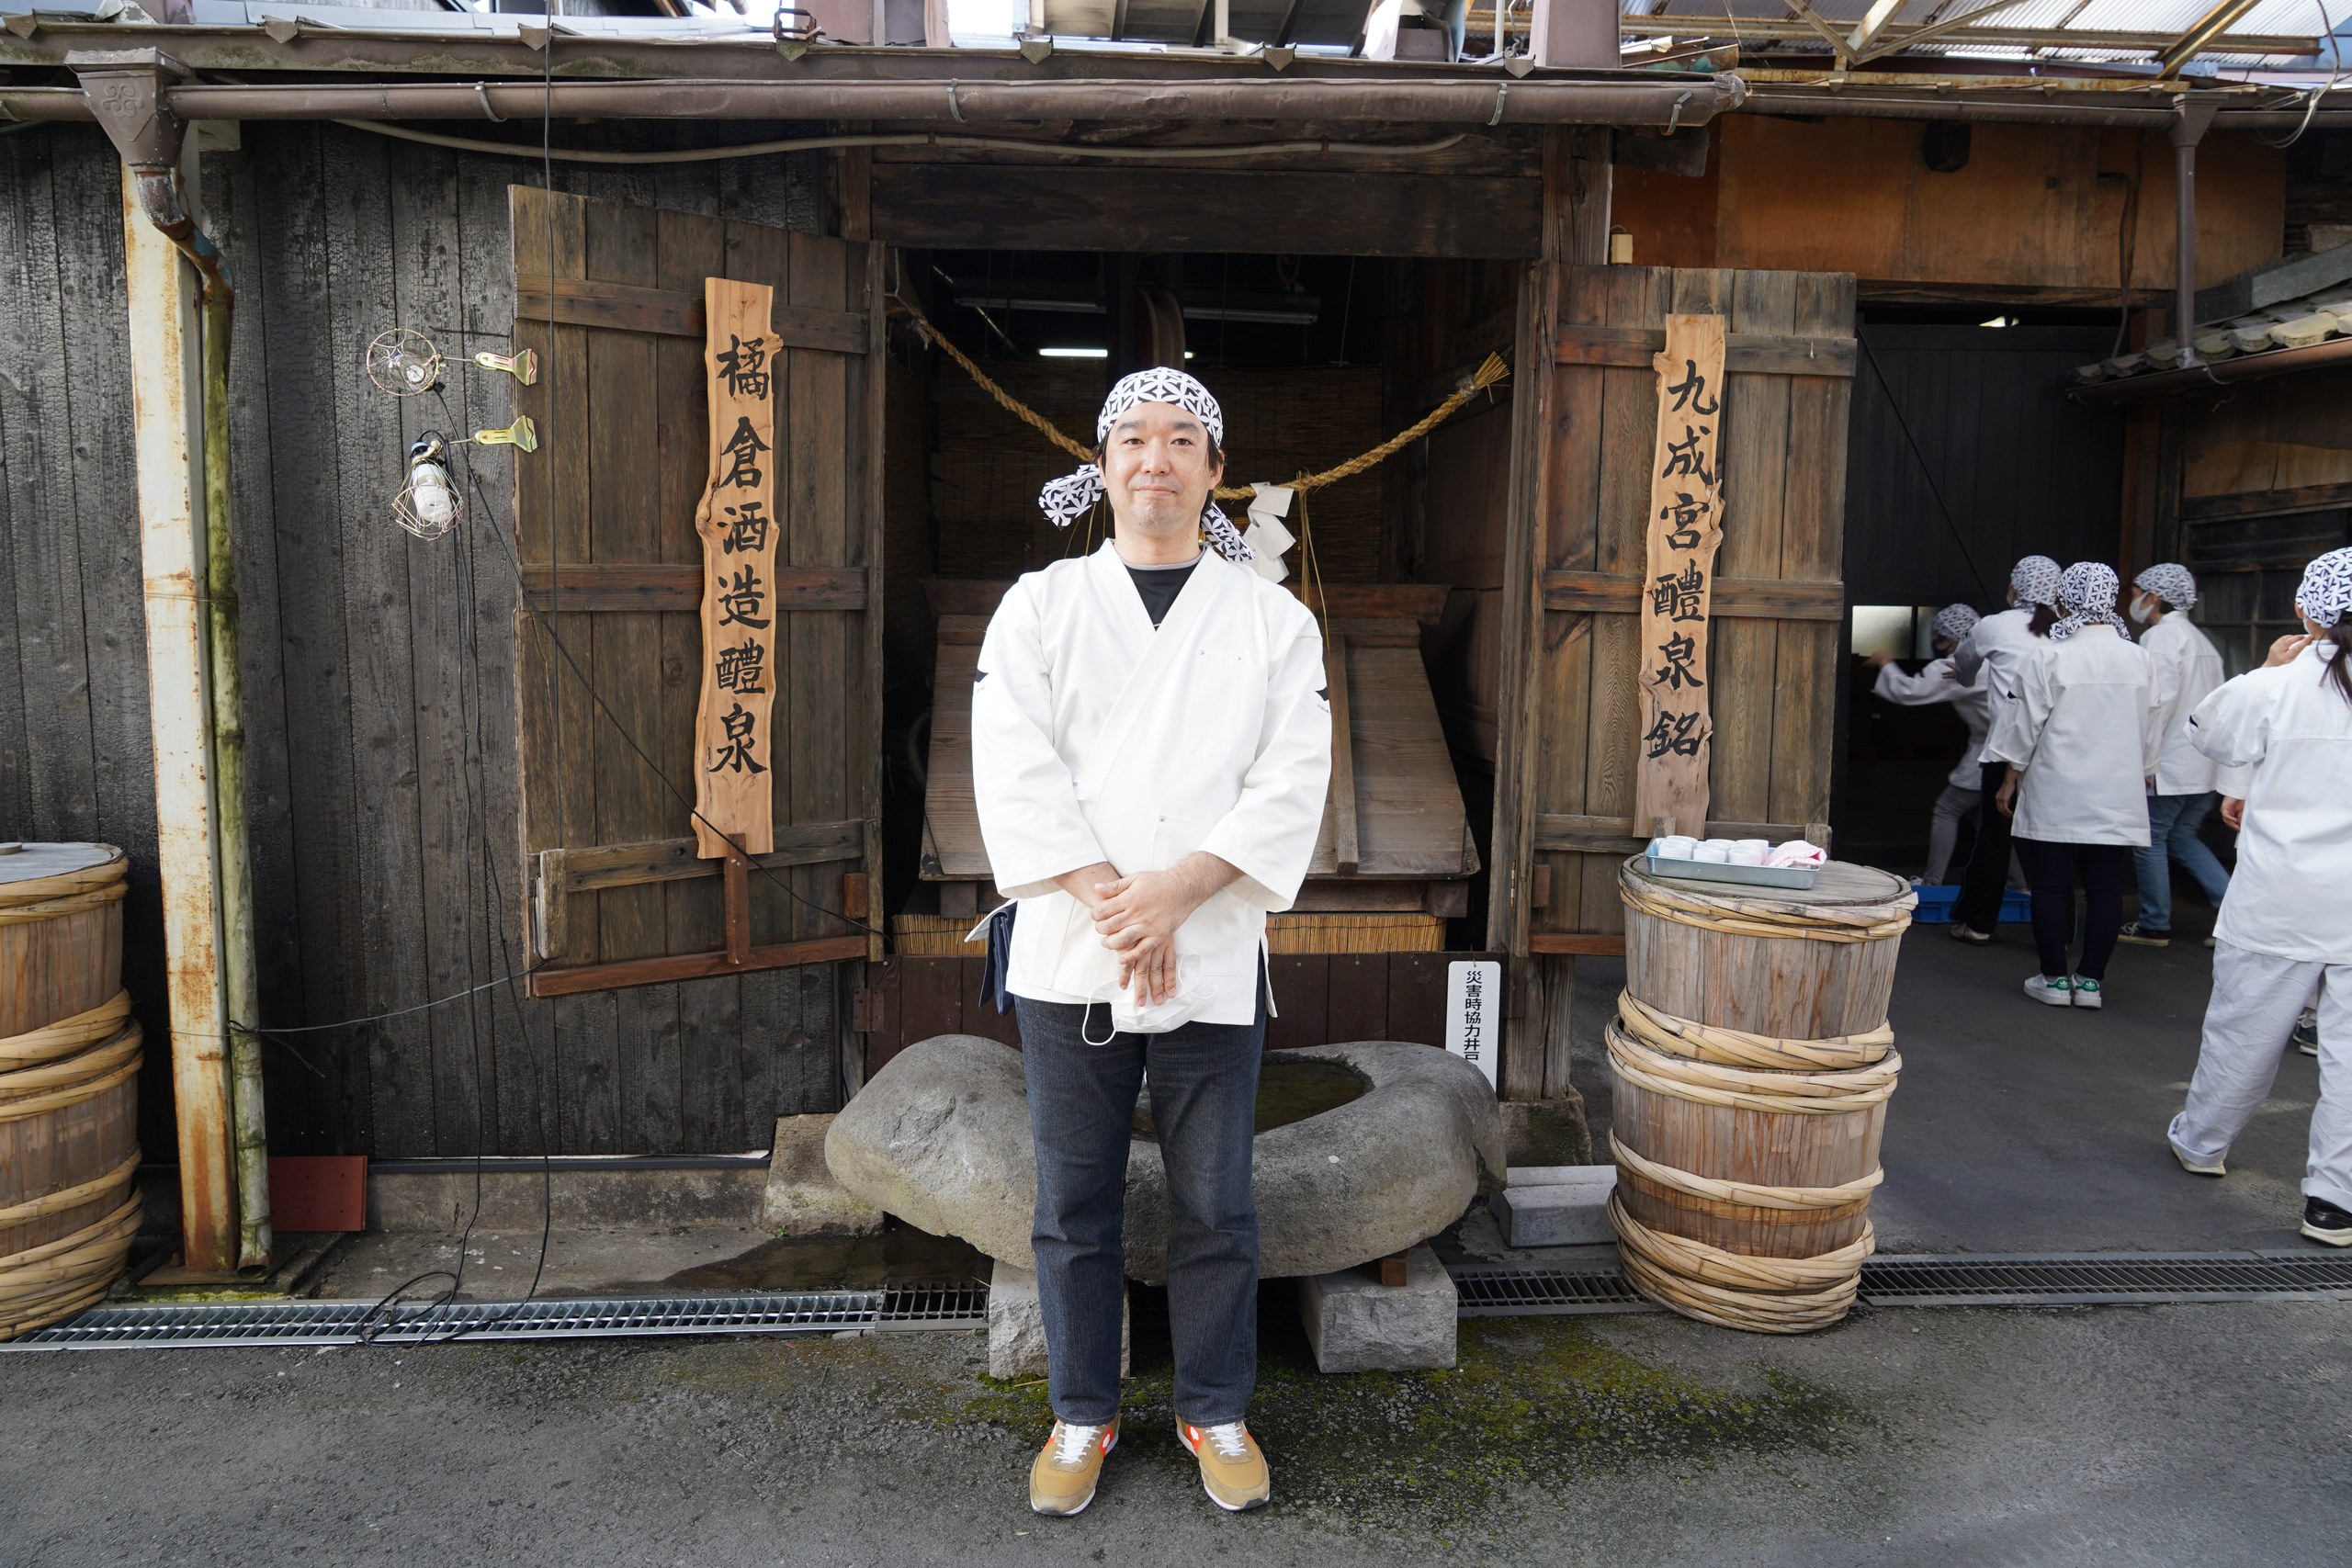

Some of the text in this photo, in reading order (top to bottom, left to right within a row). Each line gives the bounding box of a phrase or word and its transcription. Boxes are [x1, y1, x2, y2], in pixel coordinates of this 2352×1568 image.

[1643, 358, 1720, 761] 九成宮醴泉銘
